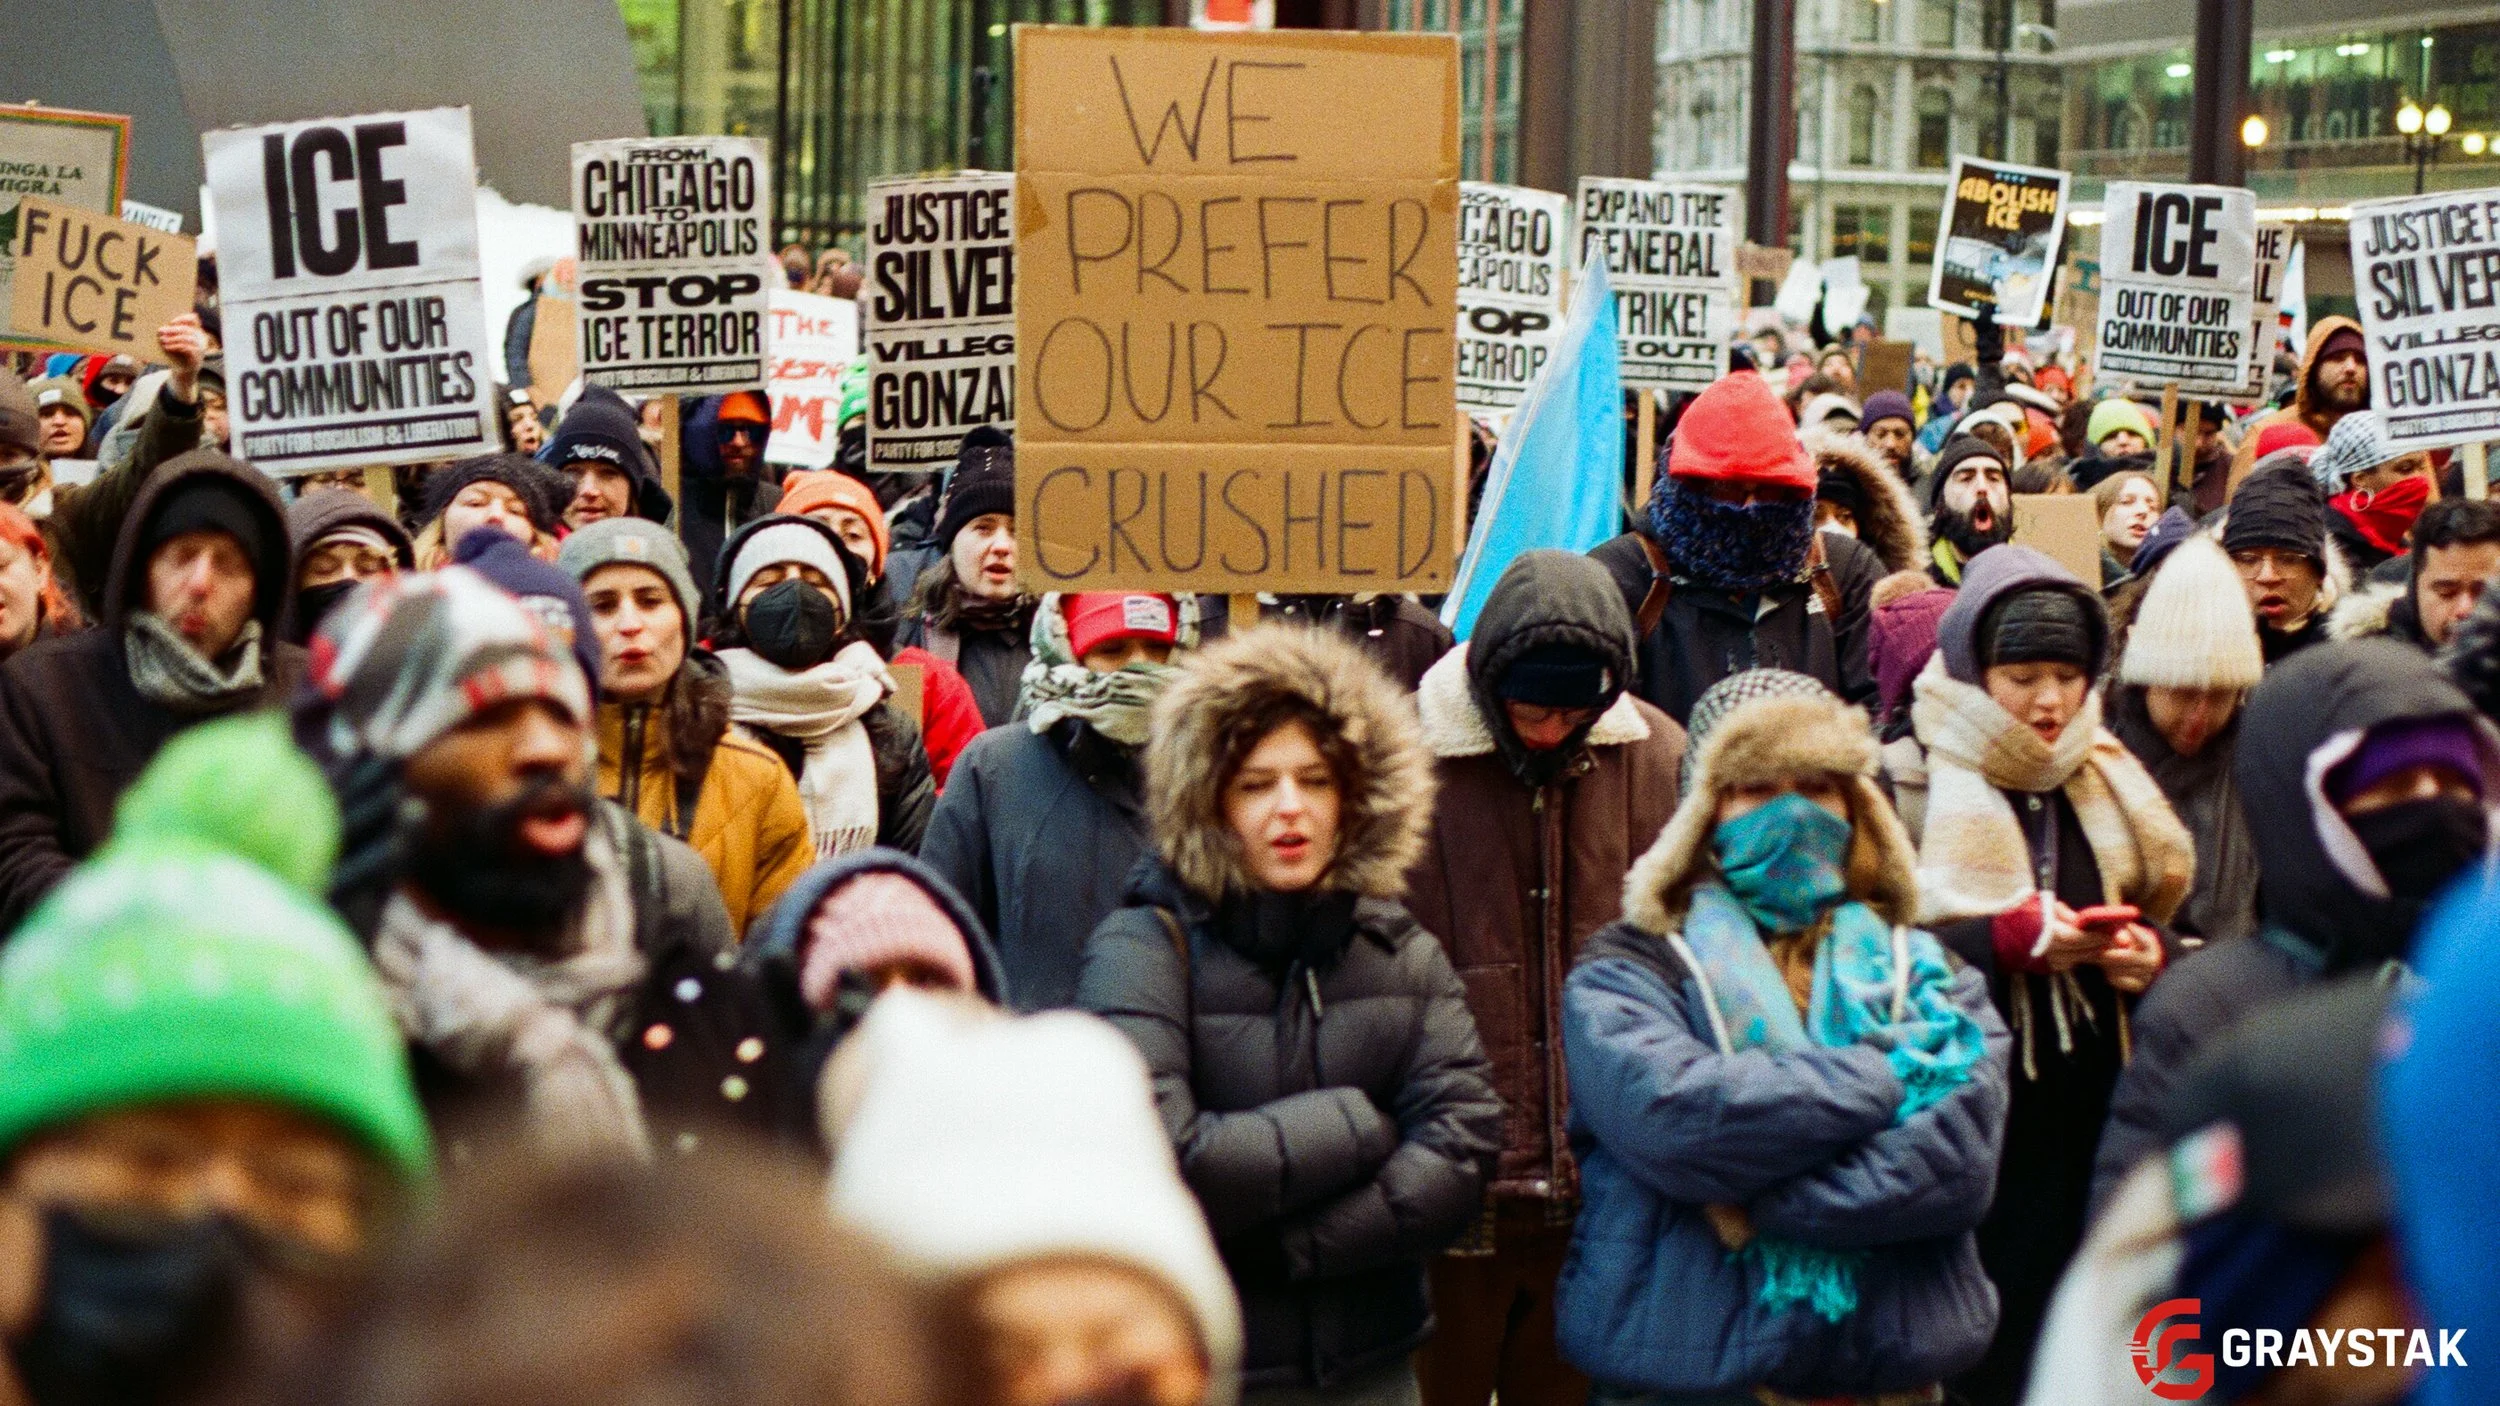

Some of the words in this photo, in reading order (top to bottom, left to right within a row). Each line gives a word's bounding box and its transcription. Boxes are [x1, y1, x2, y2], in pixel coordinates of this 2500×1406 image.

[1110, 56, 1305, 165] WE
[57, 166, 82, 180] LA
[628, 149, 707, 162] FROM
[263, 121, 419, 280] ICE
[584, 157, 755, 216] CHICAGO
[1584, 188, 1673, 225] EXPAND
[1681, 193, 1724, 227] THE
[1957, 177, 2058, 213] ABOLISH
[579, 218, 758, 261] MINNEAPOLIS
[652, 208, 689, 221] TO
[874, 189, 1009, 245] JUSTICE
[1460, 207, 1551, 257] CAGO
[1986, 203, 2020, 231] ICE
[2132, 192, 2223, 278] ICE
[2365, 203, 2483, 257] JUSTICE
[22, 208, 160, 285] FUCK
[1067, 188, 1434, 306] PREFER
[2256, 229, 2282, 260] HE
[42, 271, 139, 341] ICE
[582, 274, 760, 311] STOP
[874, 245, 1014, 322] SILVE
[2117, 289, 2157, 320] OUT
[2160, 293, 2187, 322] OF
[2188, 296, 2230, 326] OUR
[254, 306, 318, 364] OUT
[327, 302, 369, 357] OF
[377, 296, 449, 353] OUR
[583, 316, 630, 363] ICE
[637, 311, 760, 359] TERROR
[768, 309, 833, 339] THE
[1458, 305, 1550, 336] OP
[2103, 320, 2240, 360] COMMUNITIES
[2378, 324, 2500, 353] VILLEG
[872, 334, 1014, 363] VILLEG
[240, 350, 476, 422] COMMUNITIES
[874, 365, 1014, 430] GONZA
[1033, 317, 1240, 433] OUR
[1266, 322, 1444, 431] ICE
[2384, 351, 2500, 410] GONZA
[388, 423, 405, 447] &
[1031, 466, 1438, 580] CRUSHED.
